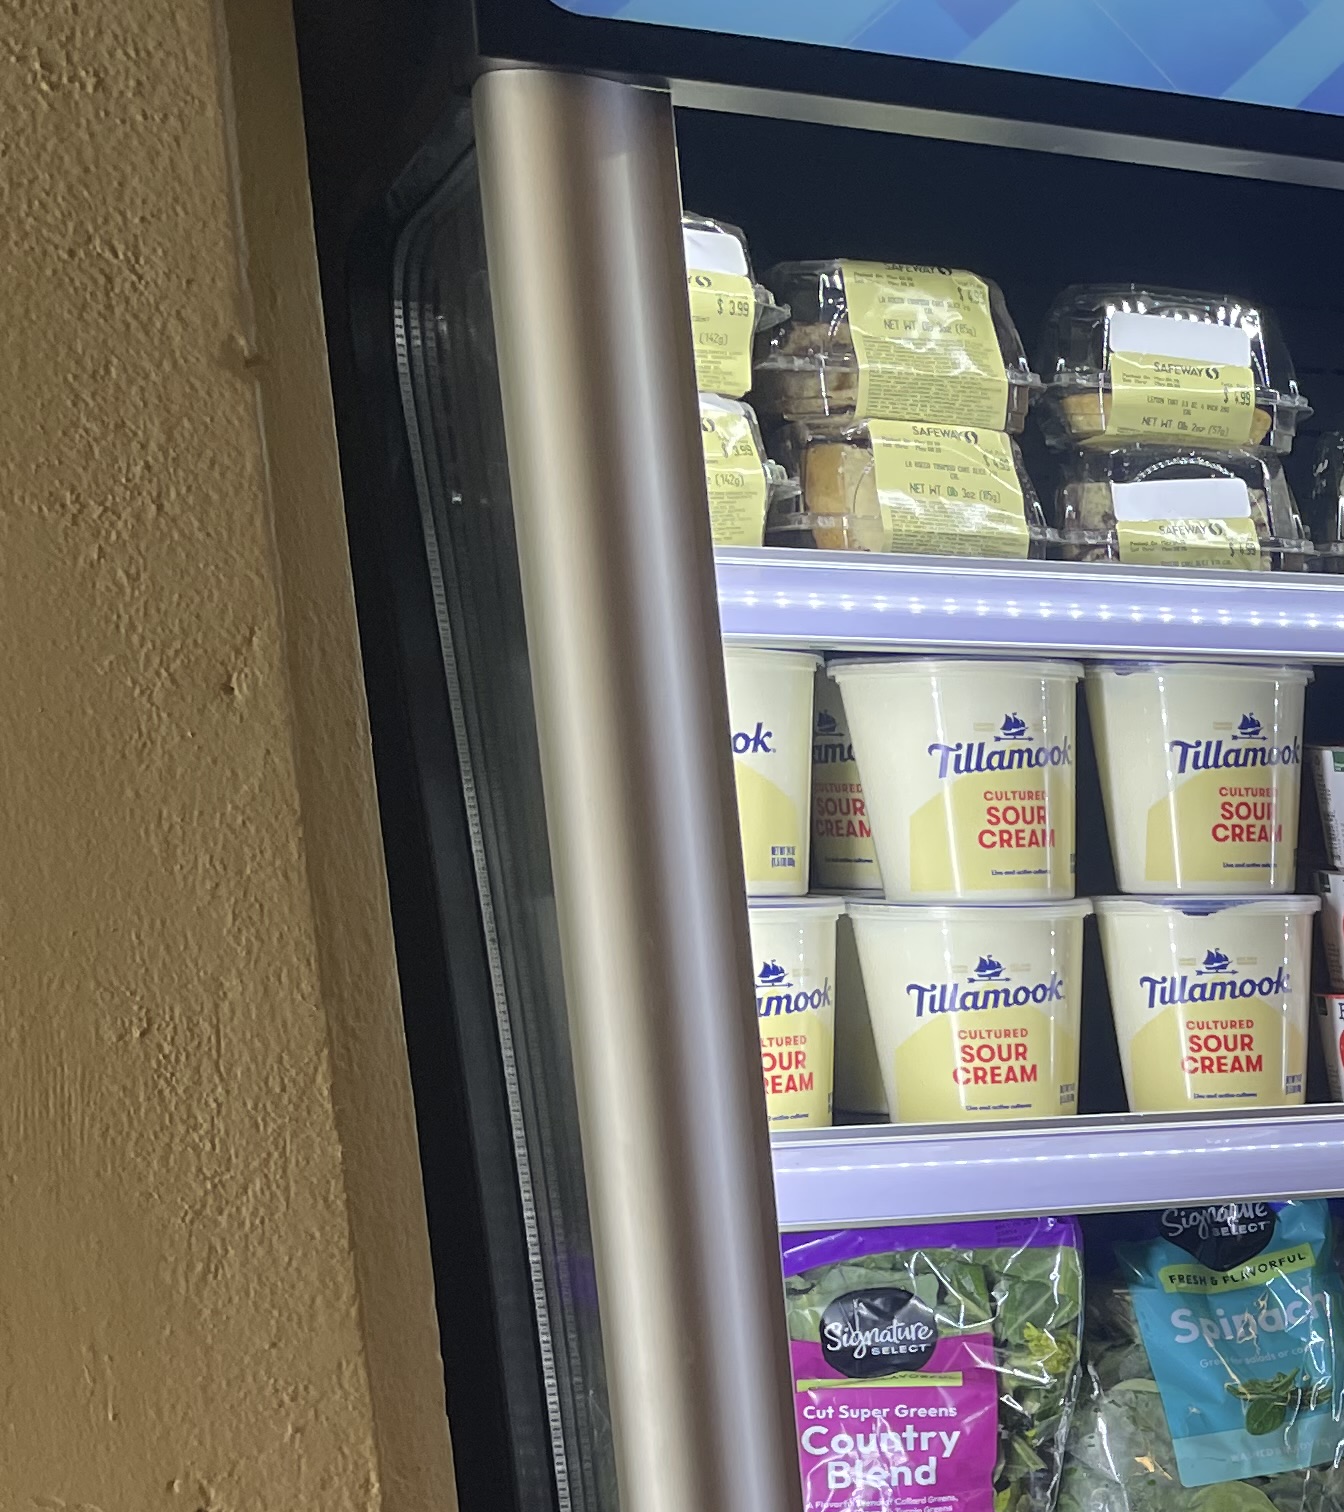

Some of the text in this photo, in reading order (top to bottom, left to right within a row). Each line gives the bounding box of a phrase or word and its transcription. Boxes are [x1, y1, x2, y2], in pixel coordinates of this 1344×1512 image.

[1153, 362, 1204, 378] SAFEWAY
[911, 426, 964, 439] SAFEWAY
[928, 736, 1073, 779] Tillamook
[1169, 737, 1301, 774] Tillamook
[983, 790, 1047, 802] CULTURED
[986, 806, 1047, 826] SOUR
[979, 829, 1056, 849] CREAM
[1212, 824, 1282, 843] CREAM
[906, 972, 1065, 1017] Tillamook
[1139, 967, 1290, 1009] Tillamook
[957, 1028, 1029, 1041] CULTURED
[1185, 1019, 1255, 1031] CULTURED
[960, 1043, 1028, 1064] SOUR
[1168, 1273, 1207, 1287] FRESH
[824, 1321, 933, 1359] Signature
[871, 1344, 927, 1356] SELECT
[803, 1404, 958, 1421] Cut Super Greens
[801, 1424, 961, 1458] Country
[827, 1456, 938, 1489] Blend
